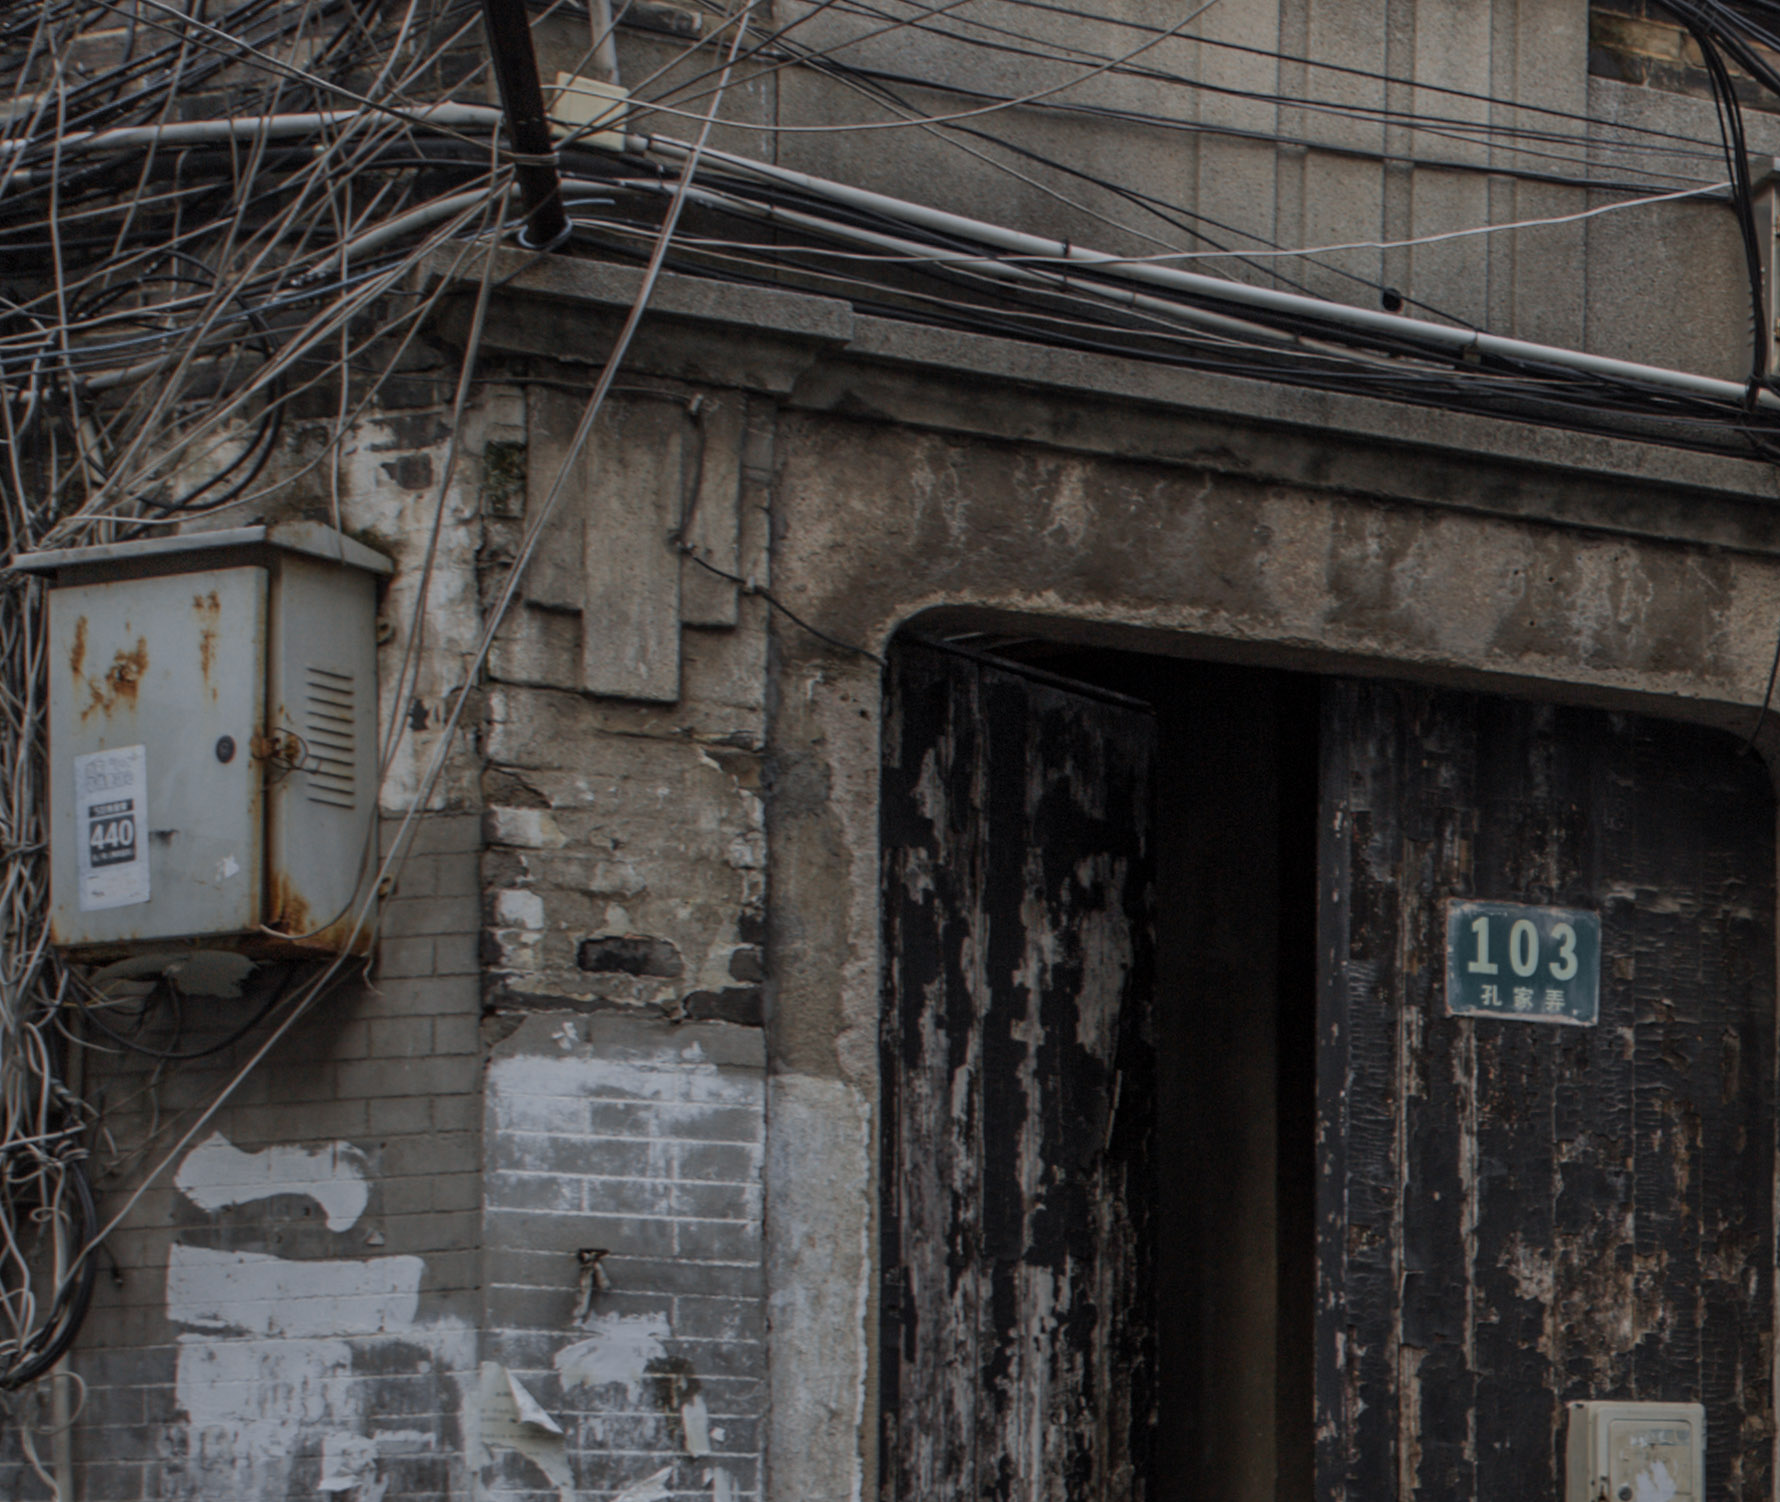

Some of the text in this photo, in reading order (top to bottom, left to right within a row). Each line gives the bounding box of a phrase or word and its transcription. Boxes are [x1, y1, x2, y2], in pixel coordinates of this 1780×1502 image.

[90, 819, 134, 851] 440
[1467, 916, 1579, 981] 103
[1480, 984, 1566, 1012] 孔家弄
